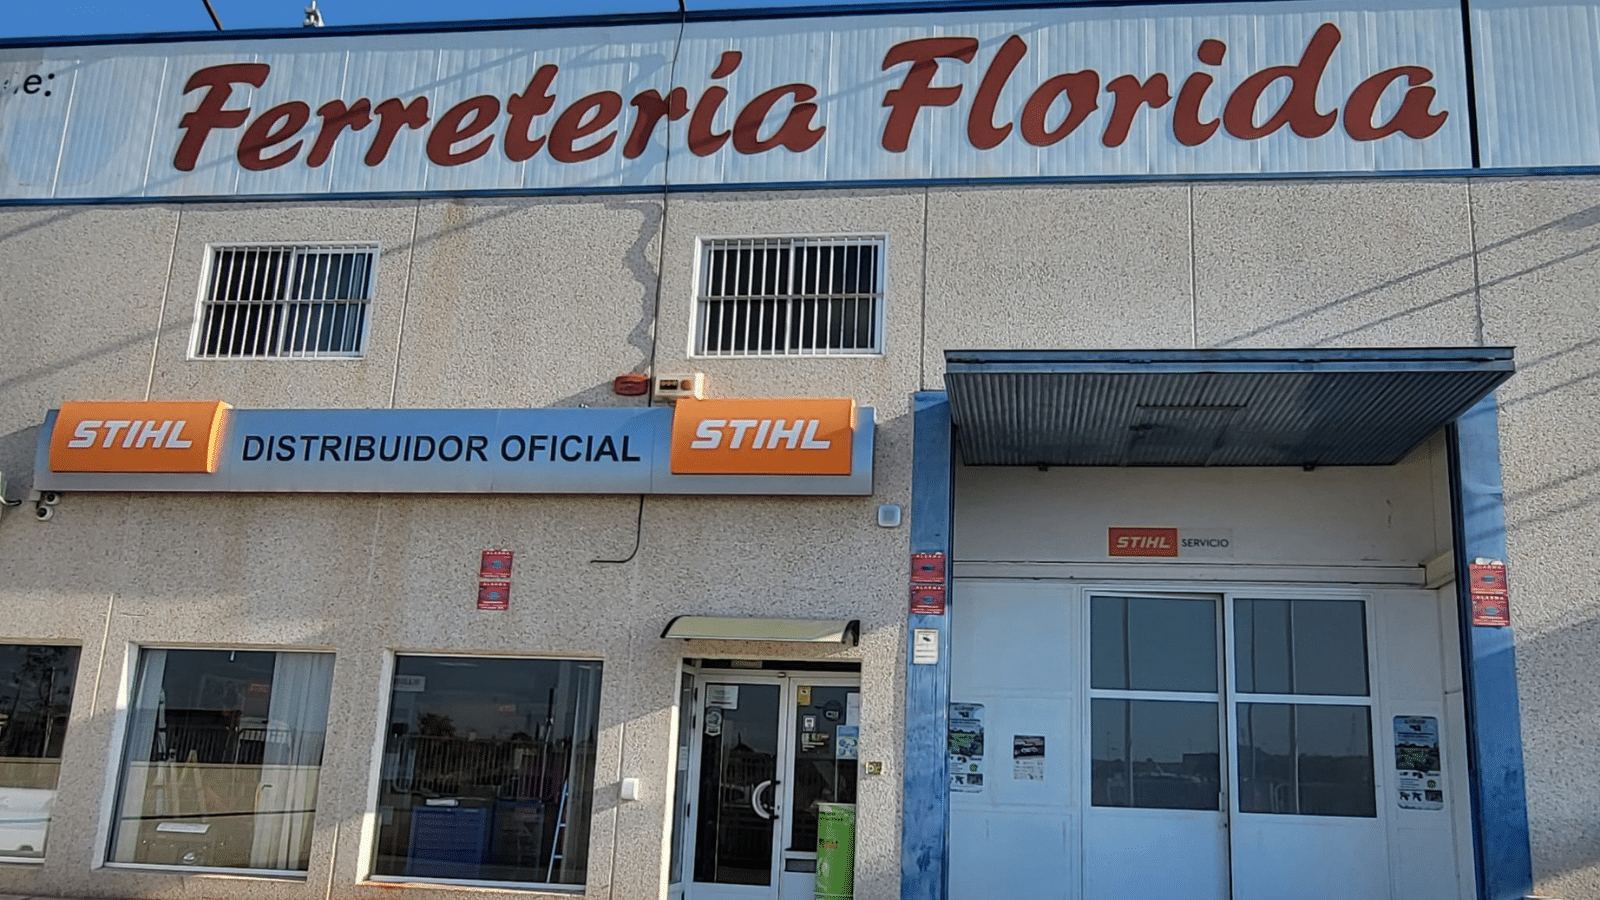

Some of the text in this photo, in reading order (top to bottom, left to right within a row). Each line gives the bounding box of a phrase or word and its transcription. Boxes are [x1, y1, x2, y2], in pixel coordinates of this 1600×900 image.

[881, 22, 1449, 154] Florida
[67, 420, 193, 449] STIHL
[241, 434, 642, 463] DISTRIBUIDOR OFICIAL
[690, 418, 832, 450] STIHL
[1116, 535, 1230, 549] STIHL SERVICIO
